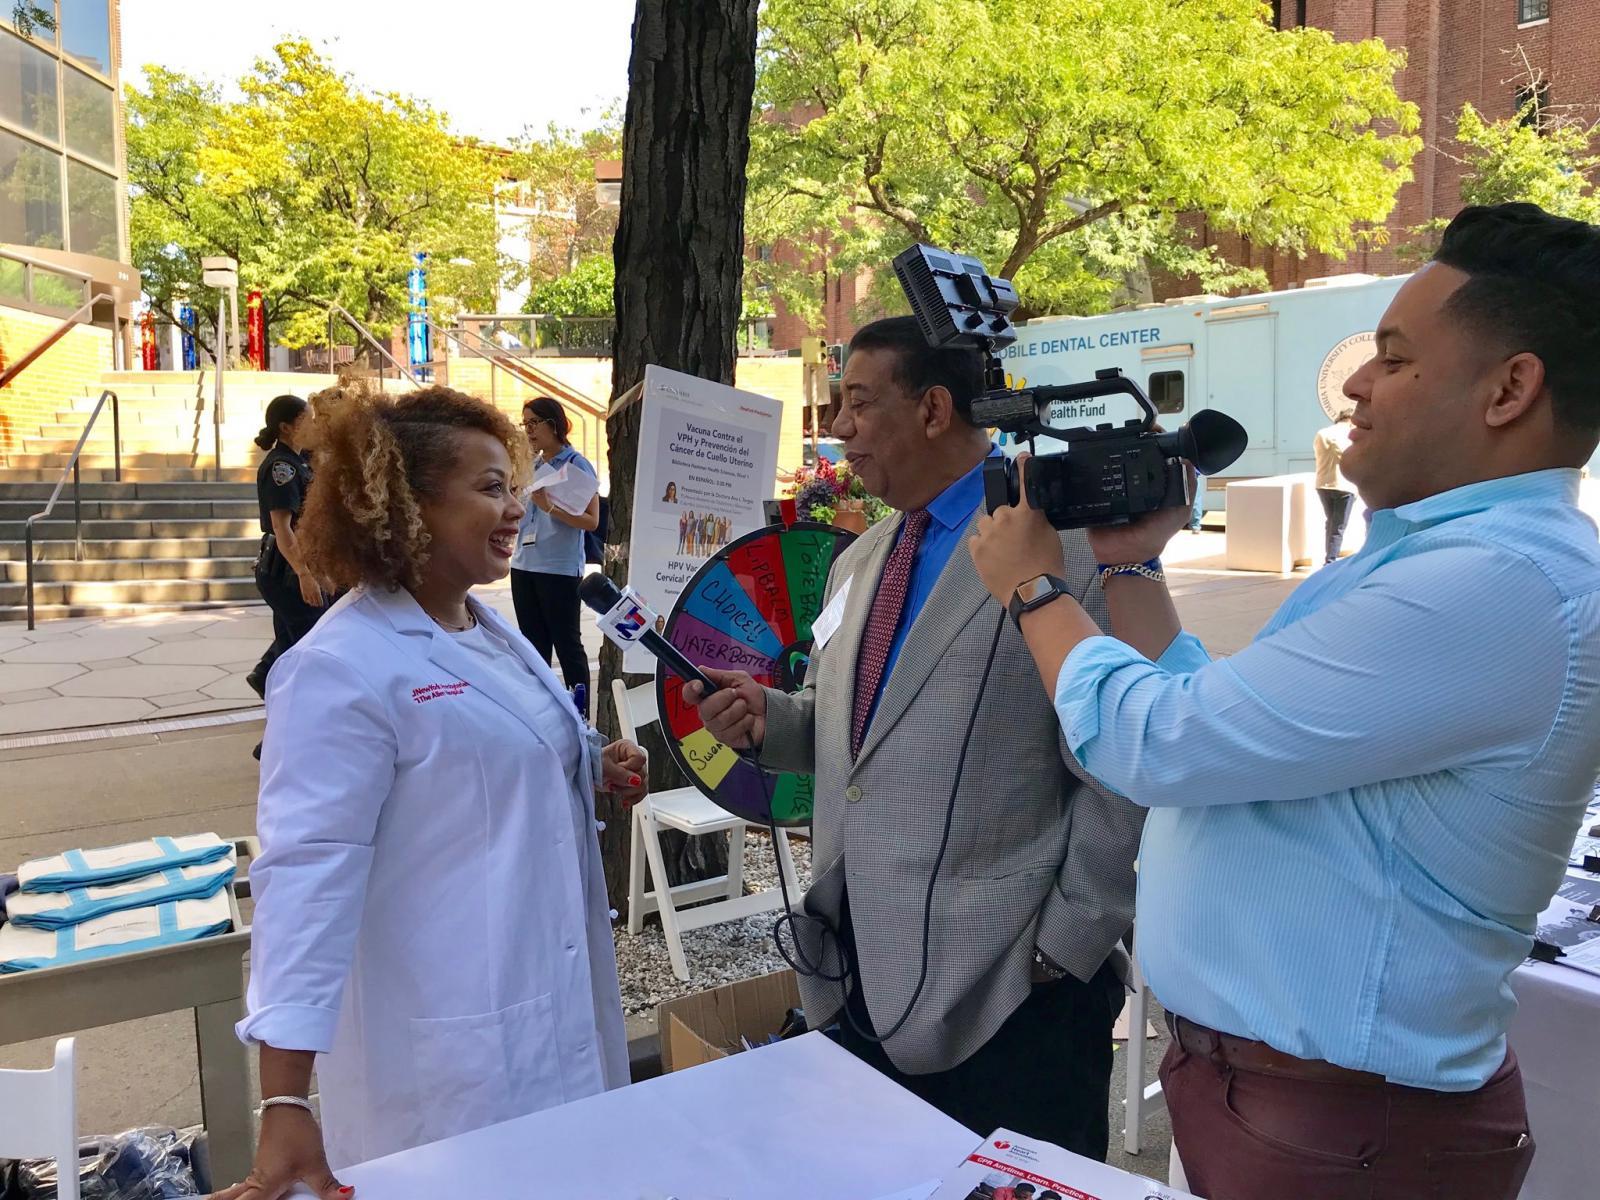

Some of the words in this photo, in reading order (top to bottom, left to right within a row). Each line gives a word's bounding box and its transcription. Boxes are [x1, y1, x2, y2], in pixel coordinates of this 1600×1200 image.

[993, 343, 1037, 360] OBILE
[1041, 335, 1096, 354] DENTAL
[1100, 327, 1161, 347] CENTER
[1319, 341, 1348, 389] UNIVERSITY
[1050, 404, 1077, 419] ealth
[1079, 403, 1105, 417] Fund
[677, 432, 693, 444] VPH
[694, 438, 699, 447] y
[700, 438, 737, 454] Prevención
[738, 447, 750, 456] del
[686, 422, 711, 436] Vacuna
[712, 430, 735, 442] Contra
[736, 435, 743, 444] el
[669, 443, 694, 455] Cáncer
[695, 448, 705, 458] de
[706, 451, 728, 463] Cuello
[729, 456, 754, 469] Uterino
[656, 572, 685, 583] Cervical
[668, 562, 684, 571] HPV
[993, 1163, 1025, 1179] Anytime.
[1026, 1173, 1050, 1187] Learn.
[1051, 1183, 1085, 1199] Practice.
